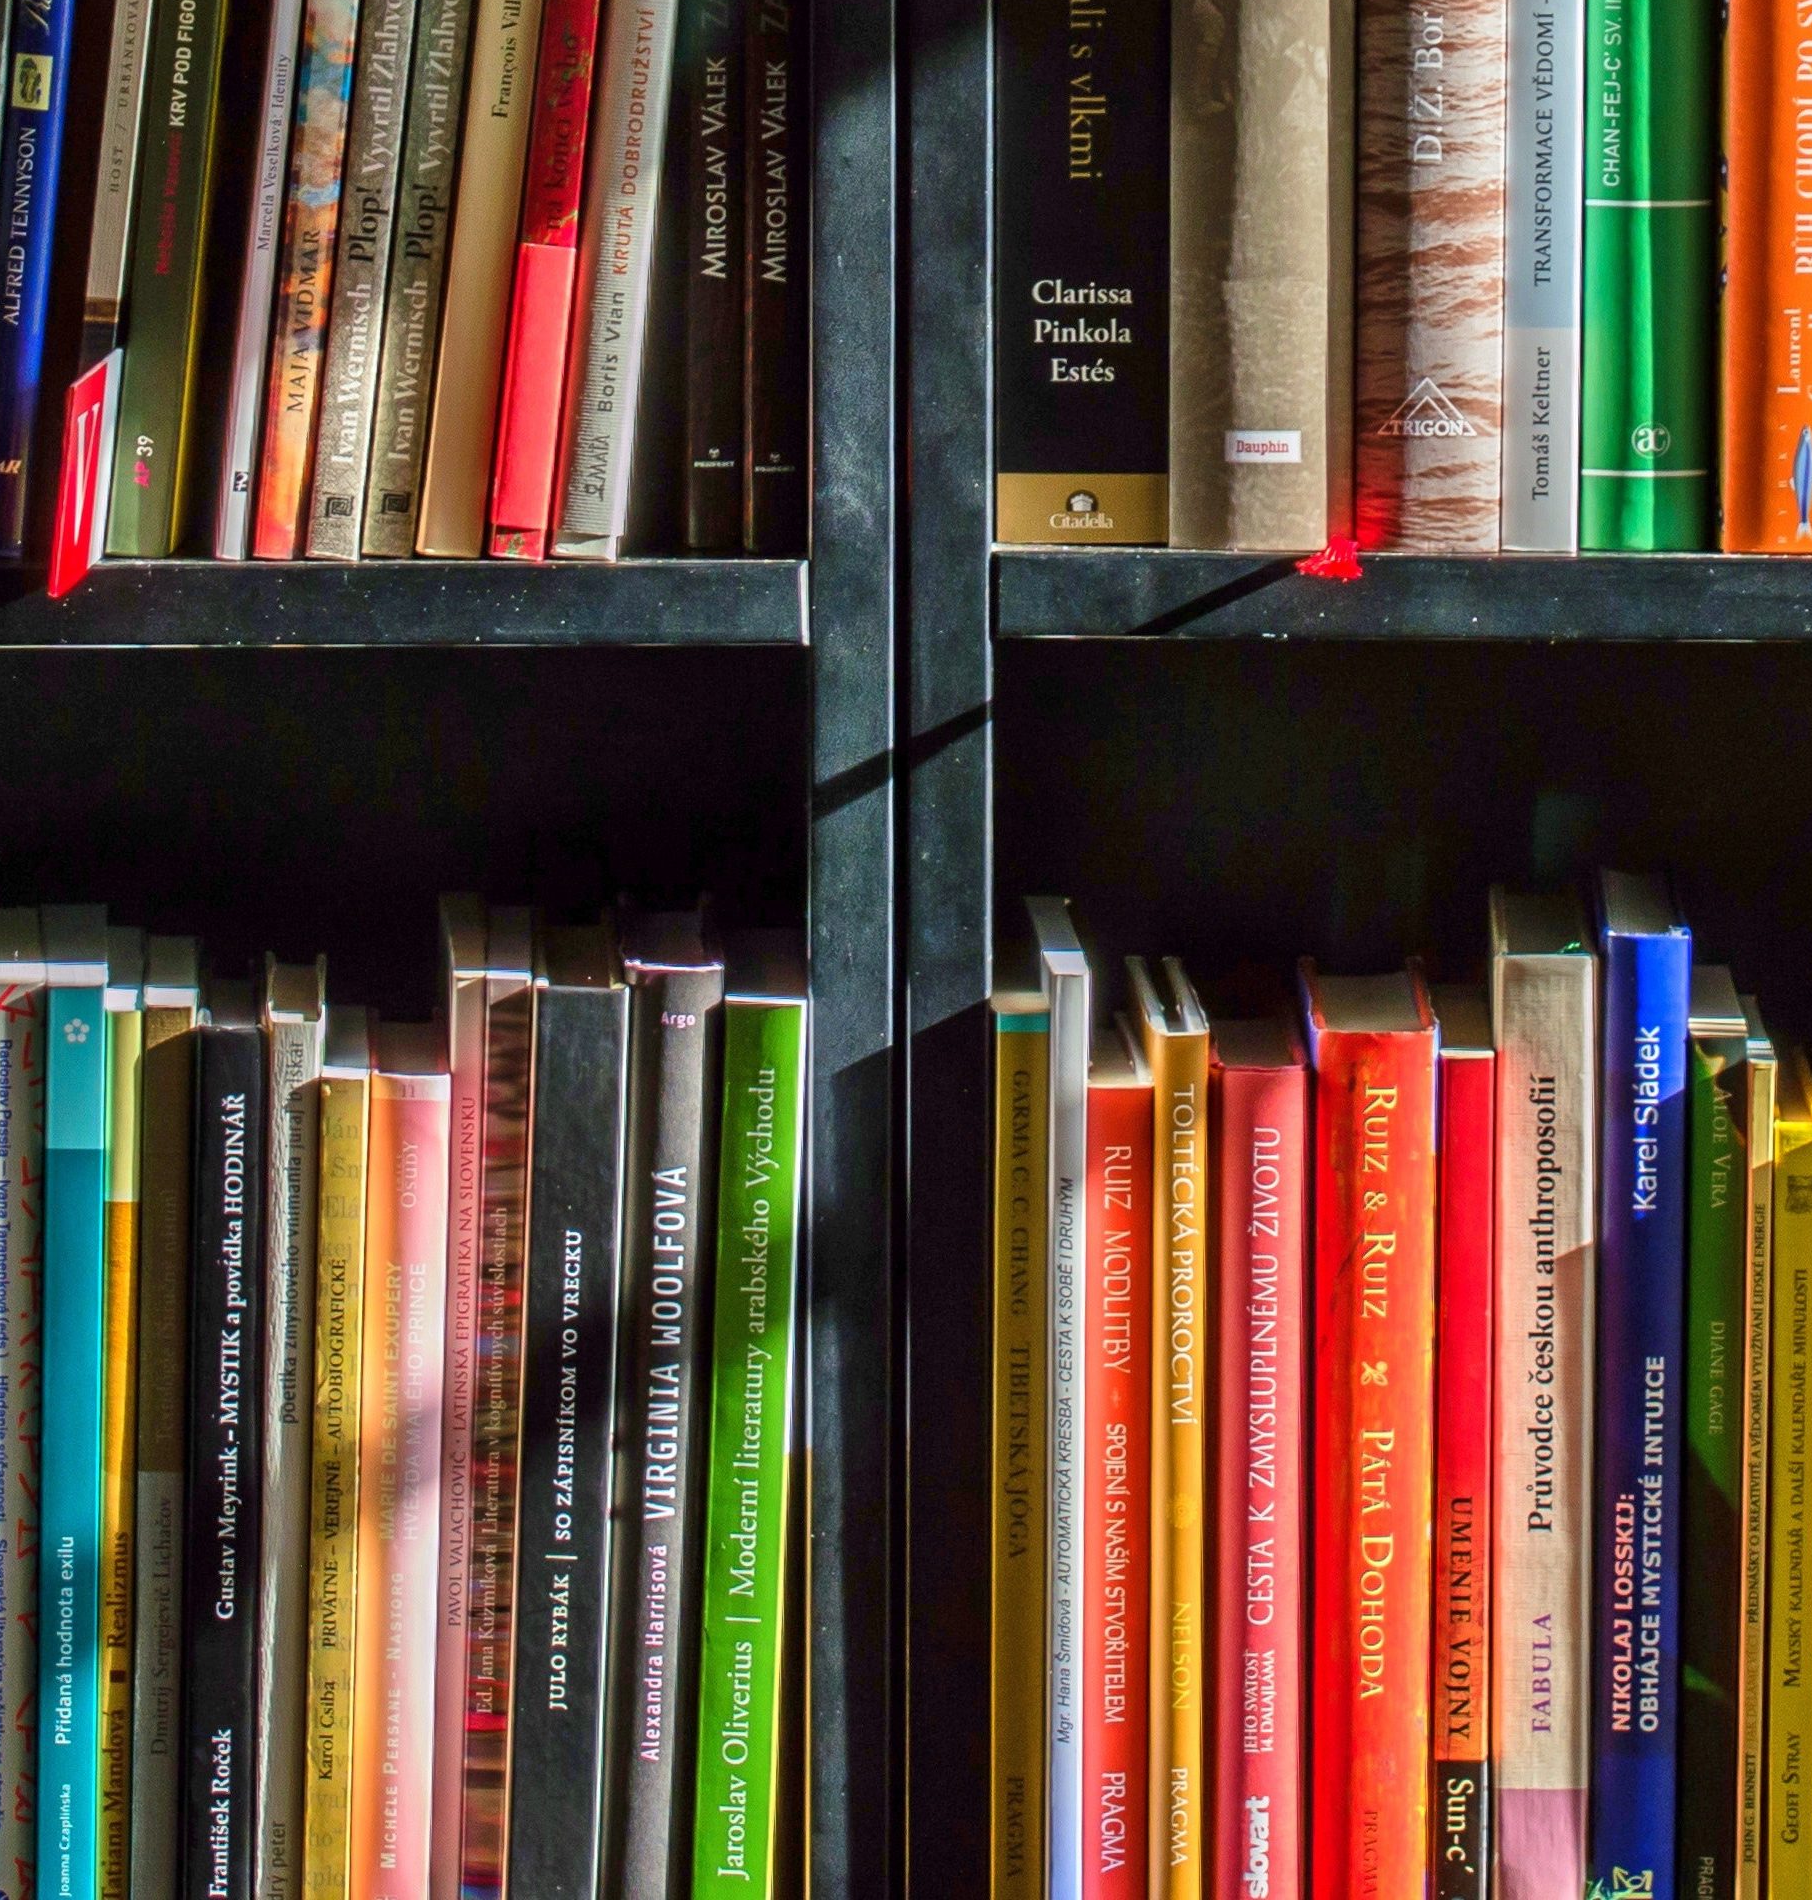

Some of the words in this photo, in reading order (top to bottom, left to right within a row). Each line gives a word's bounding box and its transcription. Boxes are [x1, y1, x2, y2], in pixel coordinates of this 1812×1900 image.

[173, 47, 193, 85] POD
[170, 90, 190, 127] KRV
[8, 127, 37, 240] TENNYSON
[1, 245, 30, 327] ALFRED
[1030, 280, 1133, 304] Clarissa
[1033, 317, 1133, 341] Pinkola
[1049, 358, 1115, 382] Estés
[1633, 1026, 1663, 1125] Sládek
[1104, 1145, 1134, 1209] RUIZ
[1246, 1126, 1282, 1237] ŽIVOTU
[1633, 1138, 1660, 1211] Karel
[643, 1166, 689, 1347] WOOLFOVÁ
[1102, 1230, 1133, 1374] MODLITBY
[1242, 1253, 1281, 1488] ZMYSLUPLNÉMU
[641, 1362, 683, 1520] VIRGINIA
[1249, 1502, 1277, 1523] K
[55, 1536, 76, 1580] exilu
[1247, 1538, 1277, 1627] CESTA
[53, 1587, 77, 1668] hodnota
[546, 1574, 572, 1646] RYBÁK
[52, 1675, 78, 1745] Přidaná
[547, 1653, 569, 1710] JULO
[721, 1640, 754, 1766] Oliverius
[717, 1773, 751, 1881] Jaroslav
